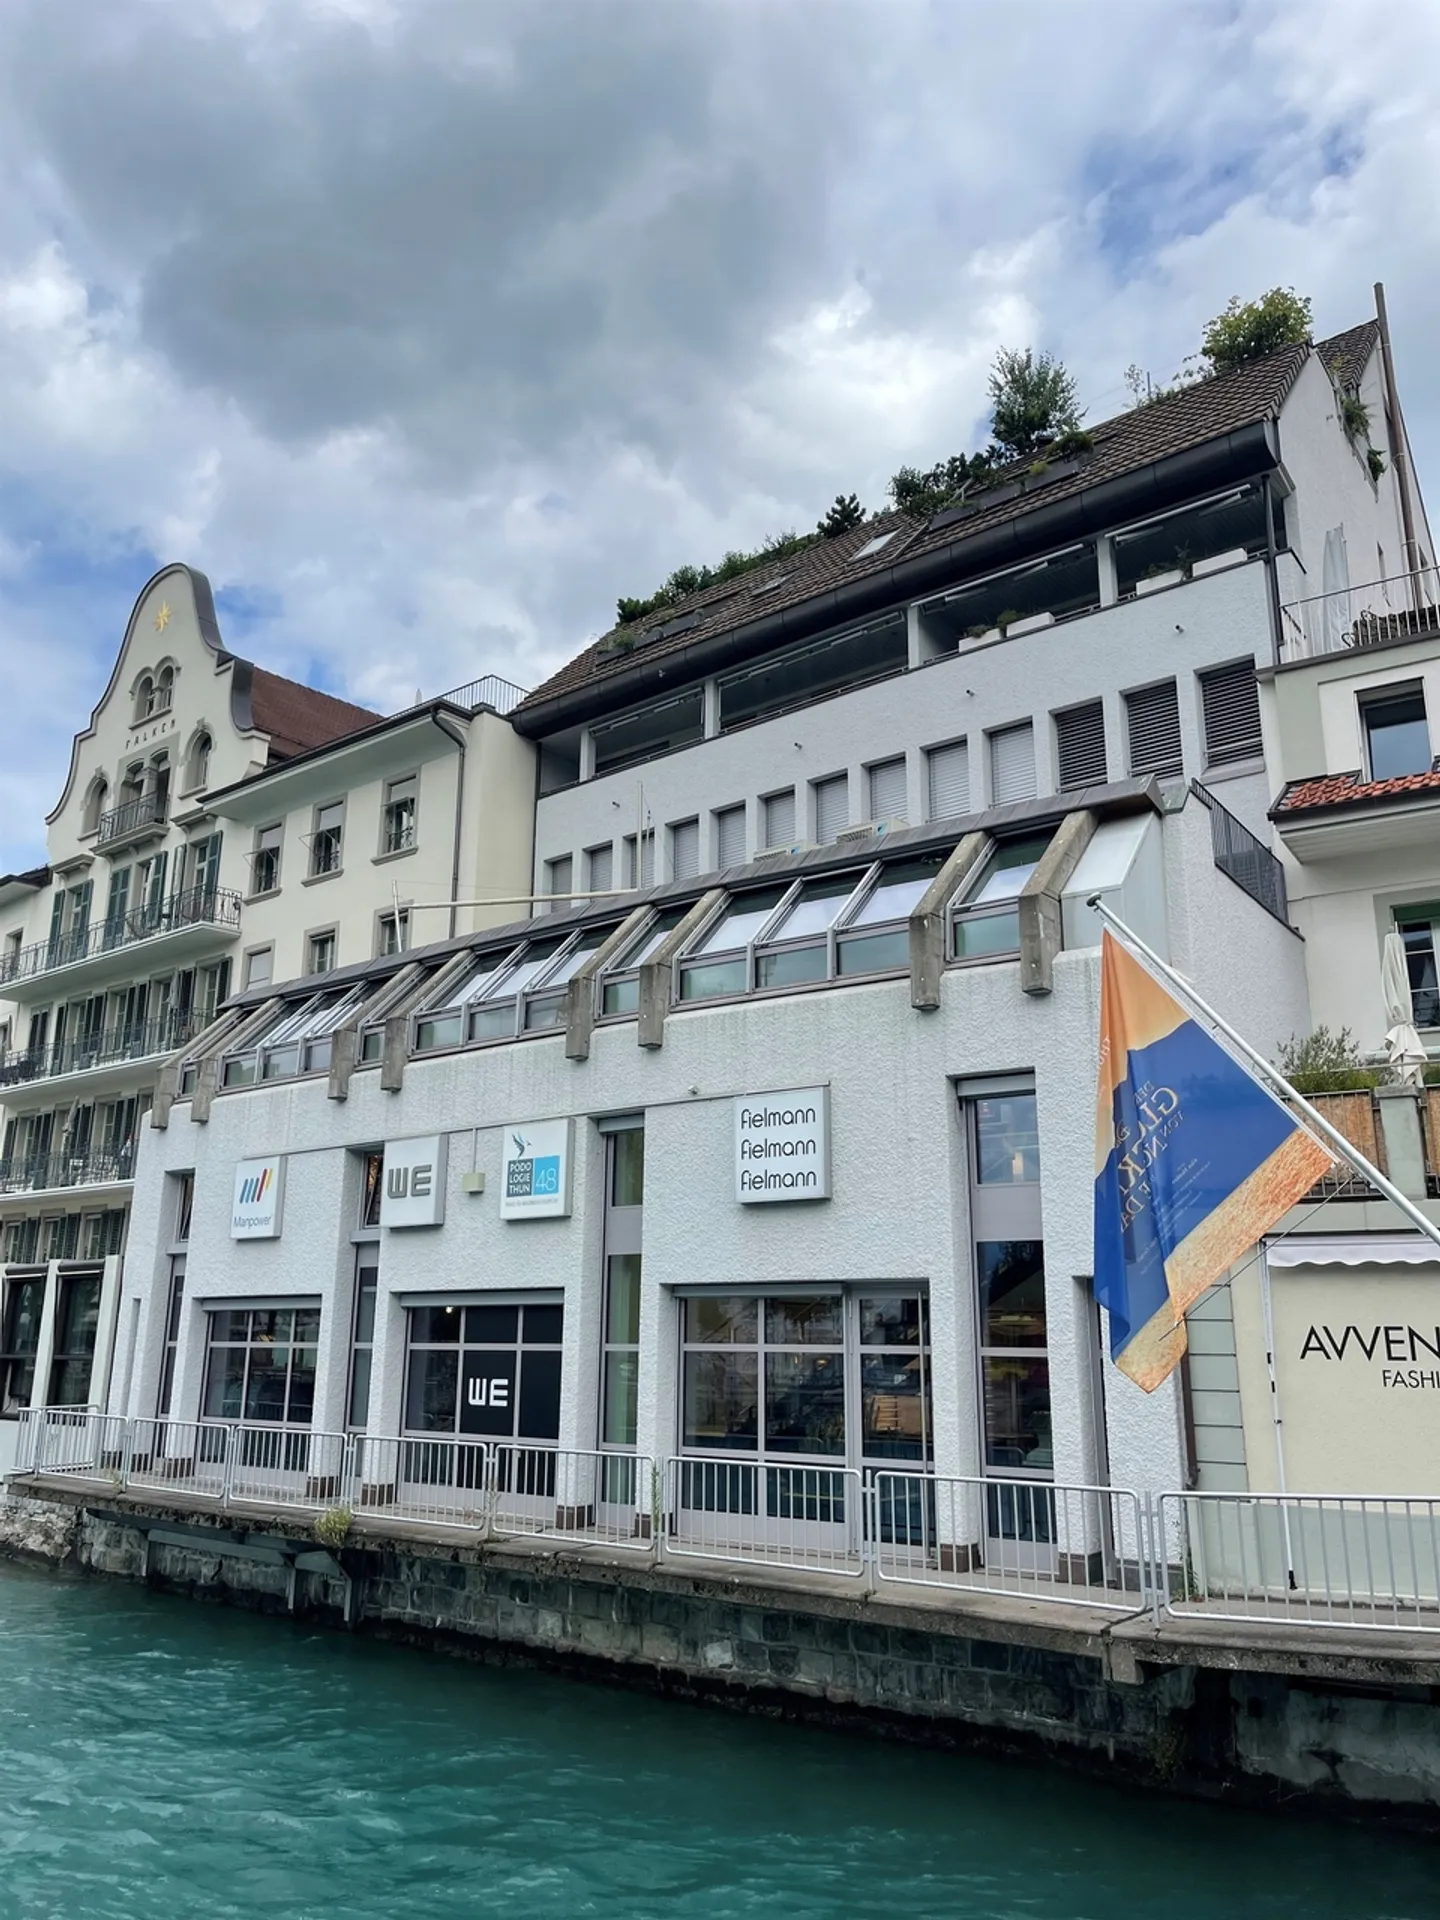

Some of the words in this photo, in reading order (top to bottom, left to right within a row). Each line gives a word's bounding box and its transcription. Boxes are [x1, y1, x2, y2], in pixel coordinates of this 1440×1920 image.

[125, 718, 176, 750] FALKEN
[741, 1107, 816, 1130] fielmann
[741, 1138, 816, 1160] fielmann
[510, 1162, 532, 1172] PODO
[387, 1164, 432, 1199] WE
[509, 1173, 531, 1184] LOGIE
[509, 1184, 531, 1194] THUN
[535, 1167, 557, 1191] 48
[741, 1169, 817, 1191] fielmann
[233, 1216, 272, 1230] Manpower
[468, 1378, 509, 1407] WE
